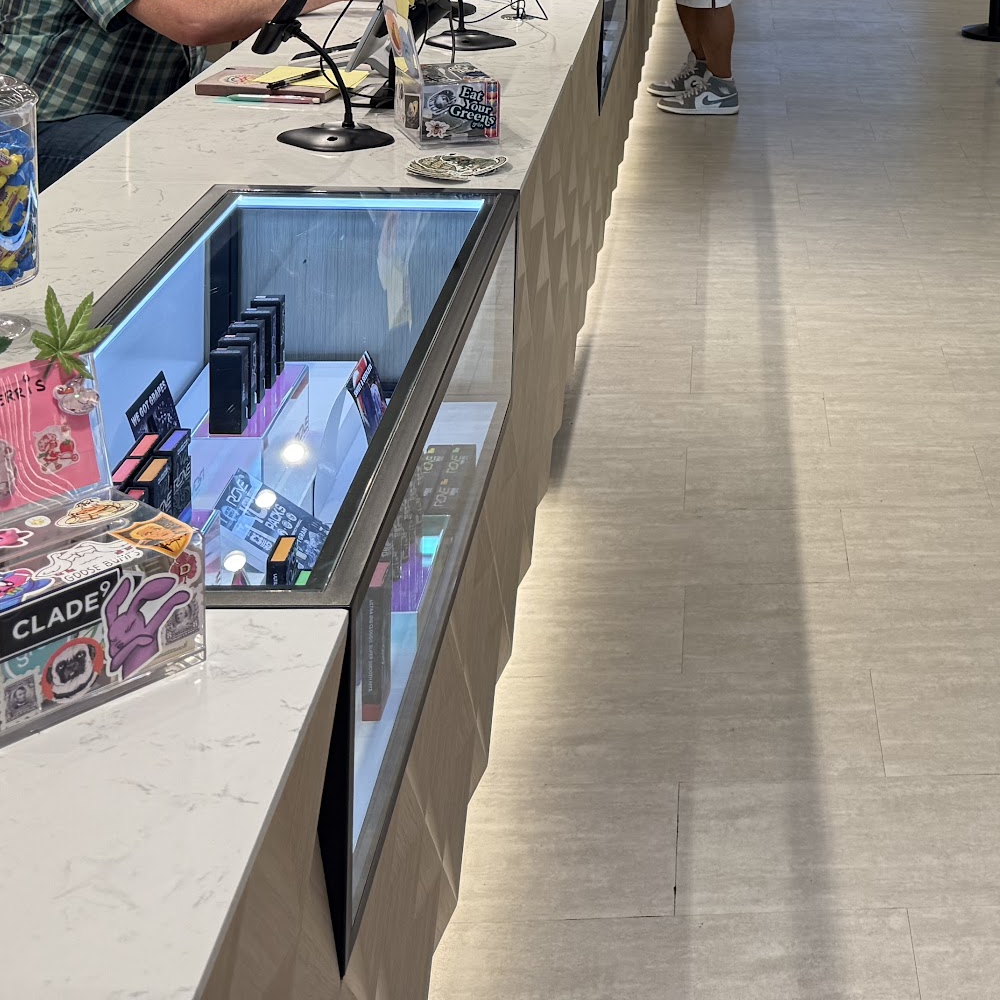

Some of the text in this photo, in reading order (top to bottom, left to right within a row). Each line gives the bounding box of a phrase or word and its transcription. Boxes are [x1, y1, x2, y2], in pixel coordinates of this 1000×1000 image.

[461, 86, 484, 101] Eat
[449, 105, 496, 127] Greens
[462, 99, 492, 114] Your
[131, 380, 168, 426] WE GOT GRAPES
[226, 480, 248, 506] ROVE
[265, 504, 286, 531] PACKS
[65, 565, 100, 582] GOOSE
